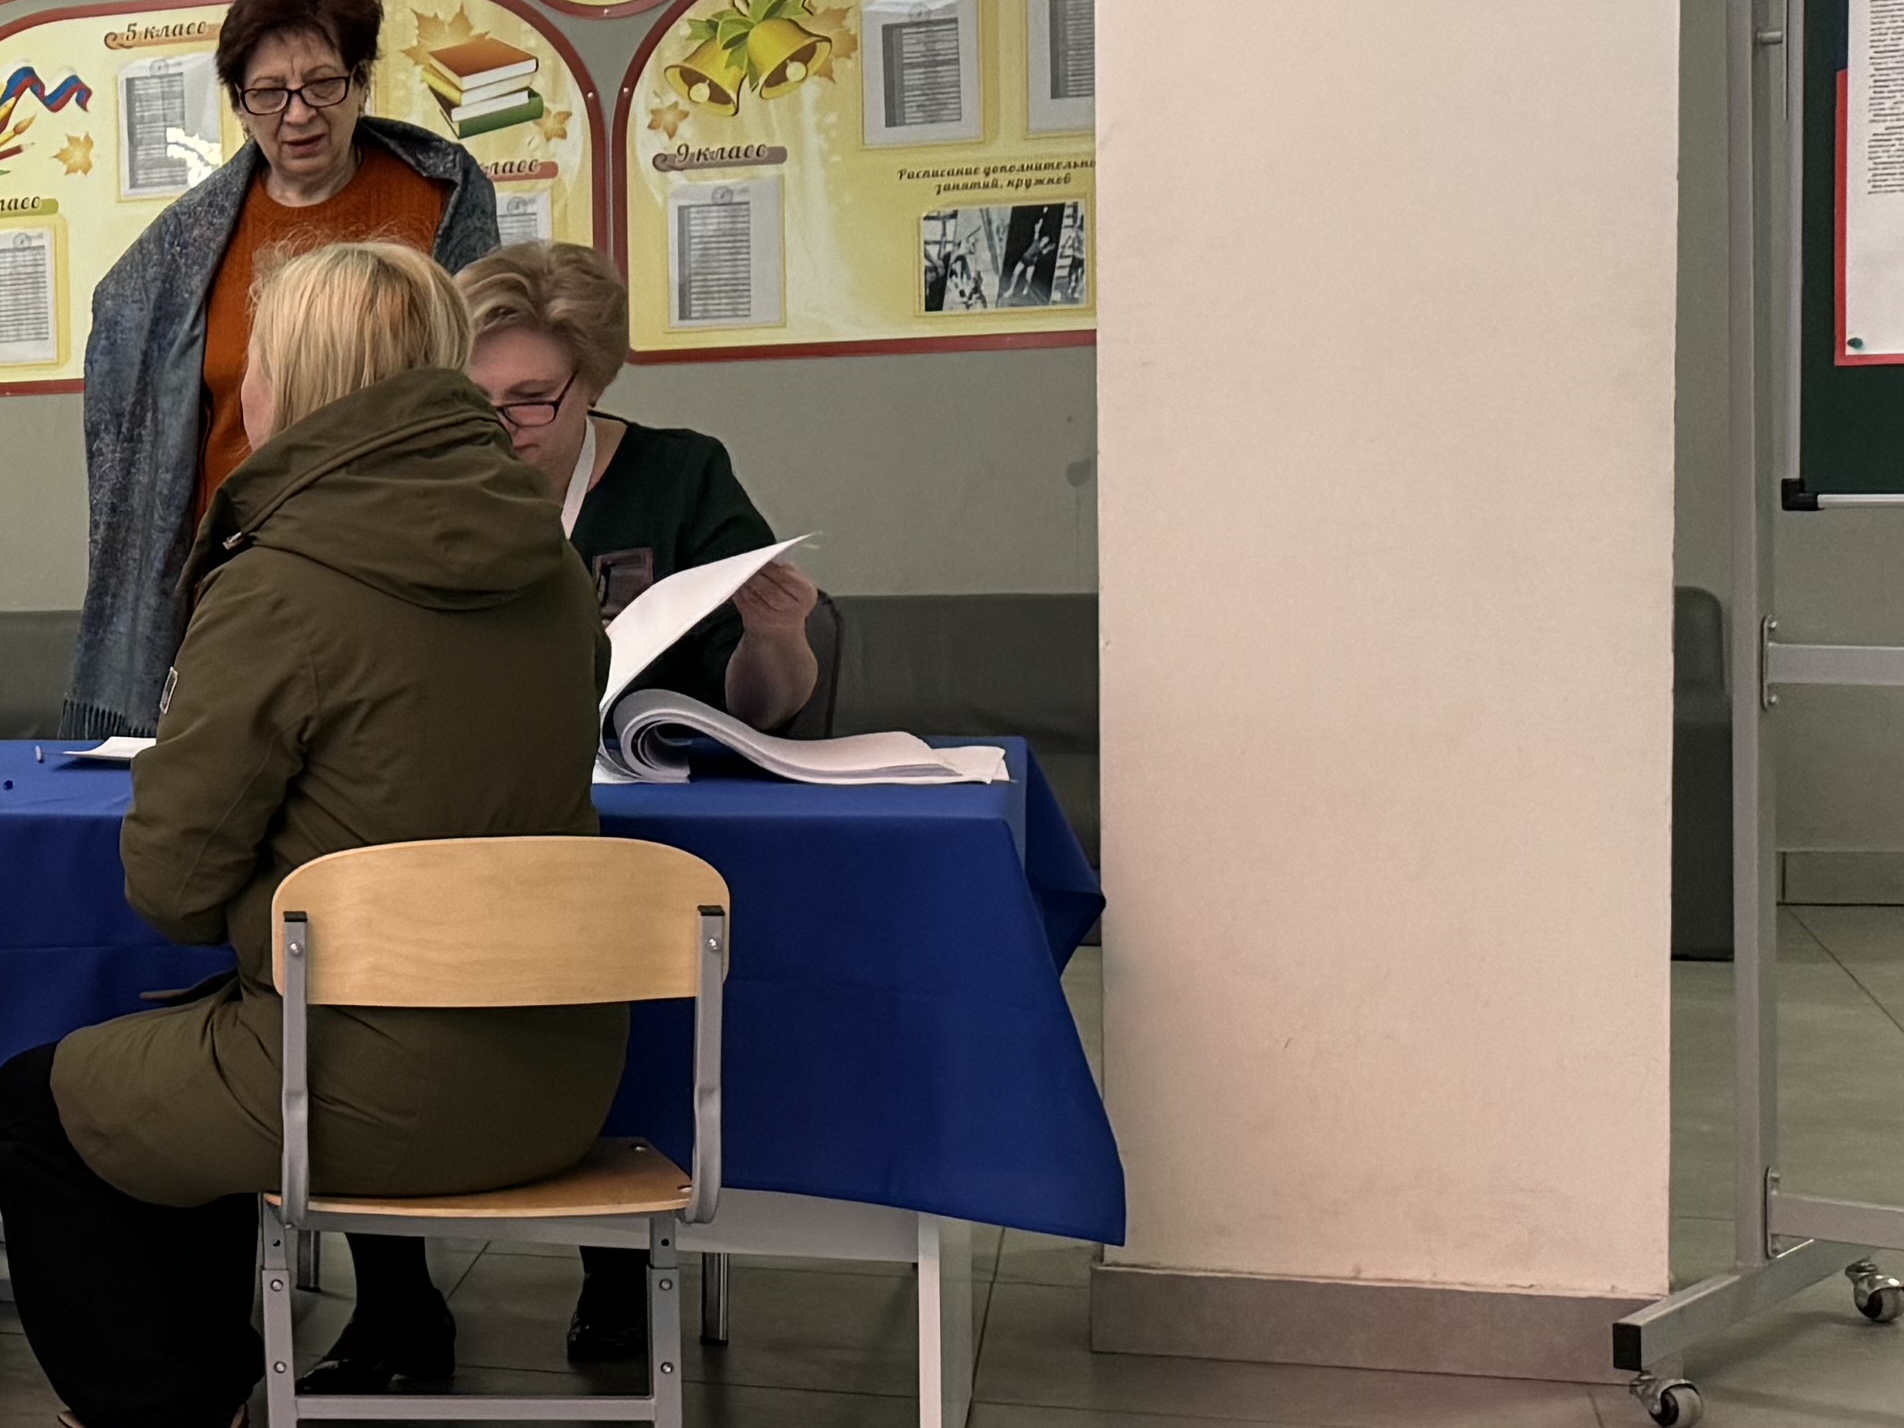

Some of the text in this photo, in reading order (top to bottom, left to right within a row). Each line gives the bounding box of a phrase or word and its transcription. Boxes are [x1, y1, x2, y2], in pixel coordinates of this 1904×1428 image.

[125, 21, 207, 42] 5 класс
[676, 143, 768, 163] 9 класс
[898, 166, 980, 181] Расписание
[1006, 172, 1072, 190] кружков
